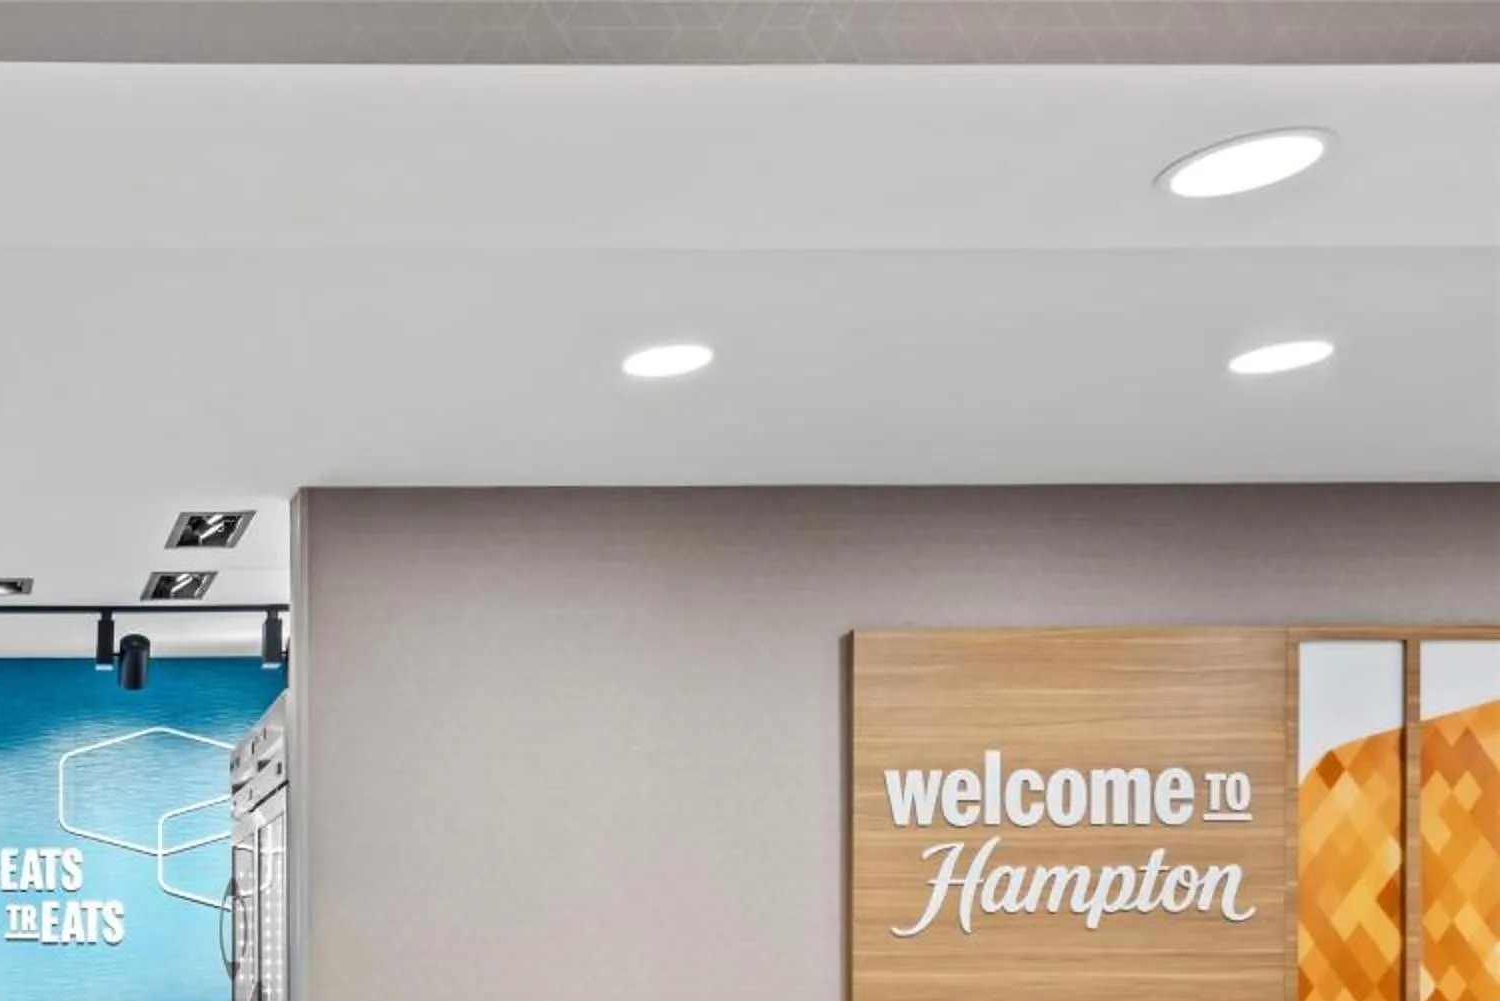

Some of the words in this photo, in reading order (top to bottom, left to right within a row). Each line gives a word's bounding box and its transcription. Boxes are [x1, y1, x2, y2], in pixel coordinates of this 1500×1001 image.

[884, 750, 1195, 827] welcome
[1203, 771, 1253, 822] TO
[5, 900, 125, 945] TREATS
[890, 836, 1257, 938] Hampton
